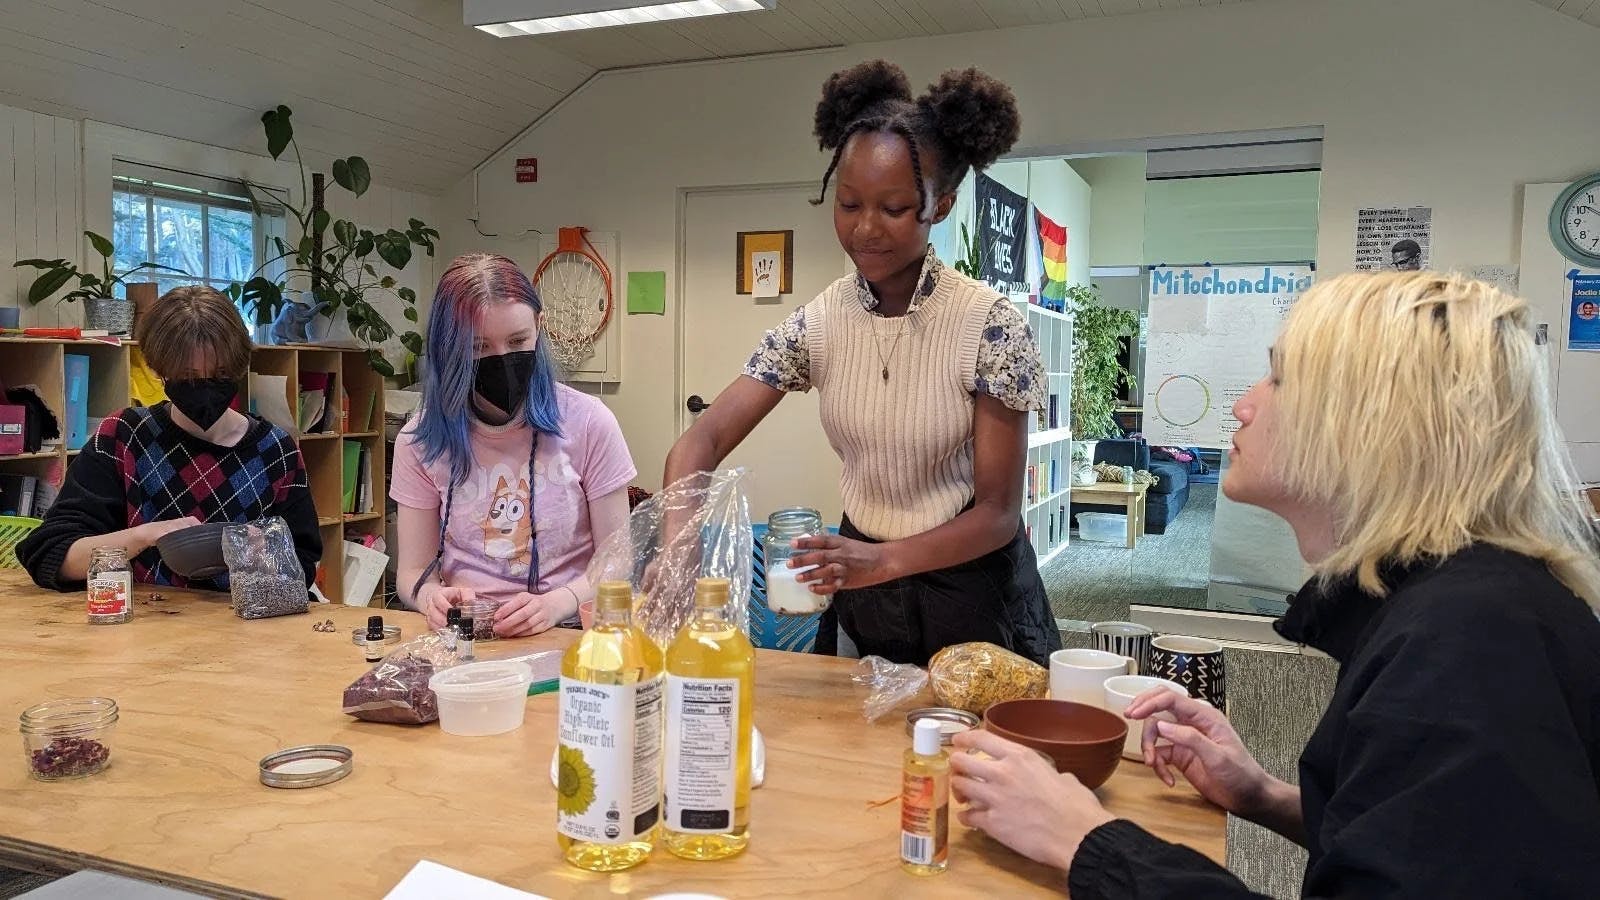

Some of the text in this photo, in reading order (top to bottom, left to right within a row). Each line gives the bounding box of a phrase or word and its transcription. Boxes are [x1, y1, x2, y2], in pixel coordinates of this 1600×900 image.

[1588, 195, 1594, 203] 11
[1576, 206, 1586, 214] 10
[990, 197, 1015, 238] BLACK
[1574, 218, 1581, 227] 9
[1580, 231, 1586, 239] 8
[1592, 238, 1599, 247] 7
[1152, 267, 1312, 295] Mitochondria
[683, 684, 732, 692] Nutrition Facts
[571, 695, 601, 713] Organic
[601, 734, 616, 748] Oil
